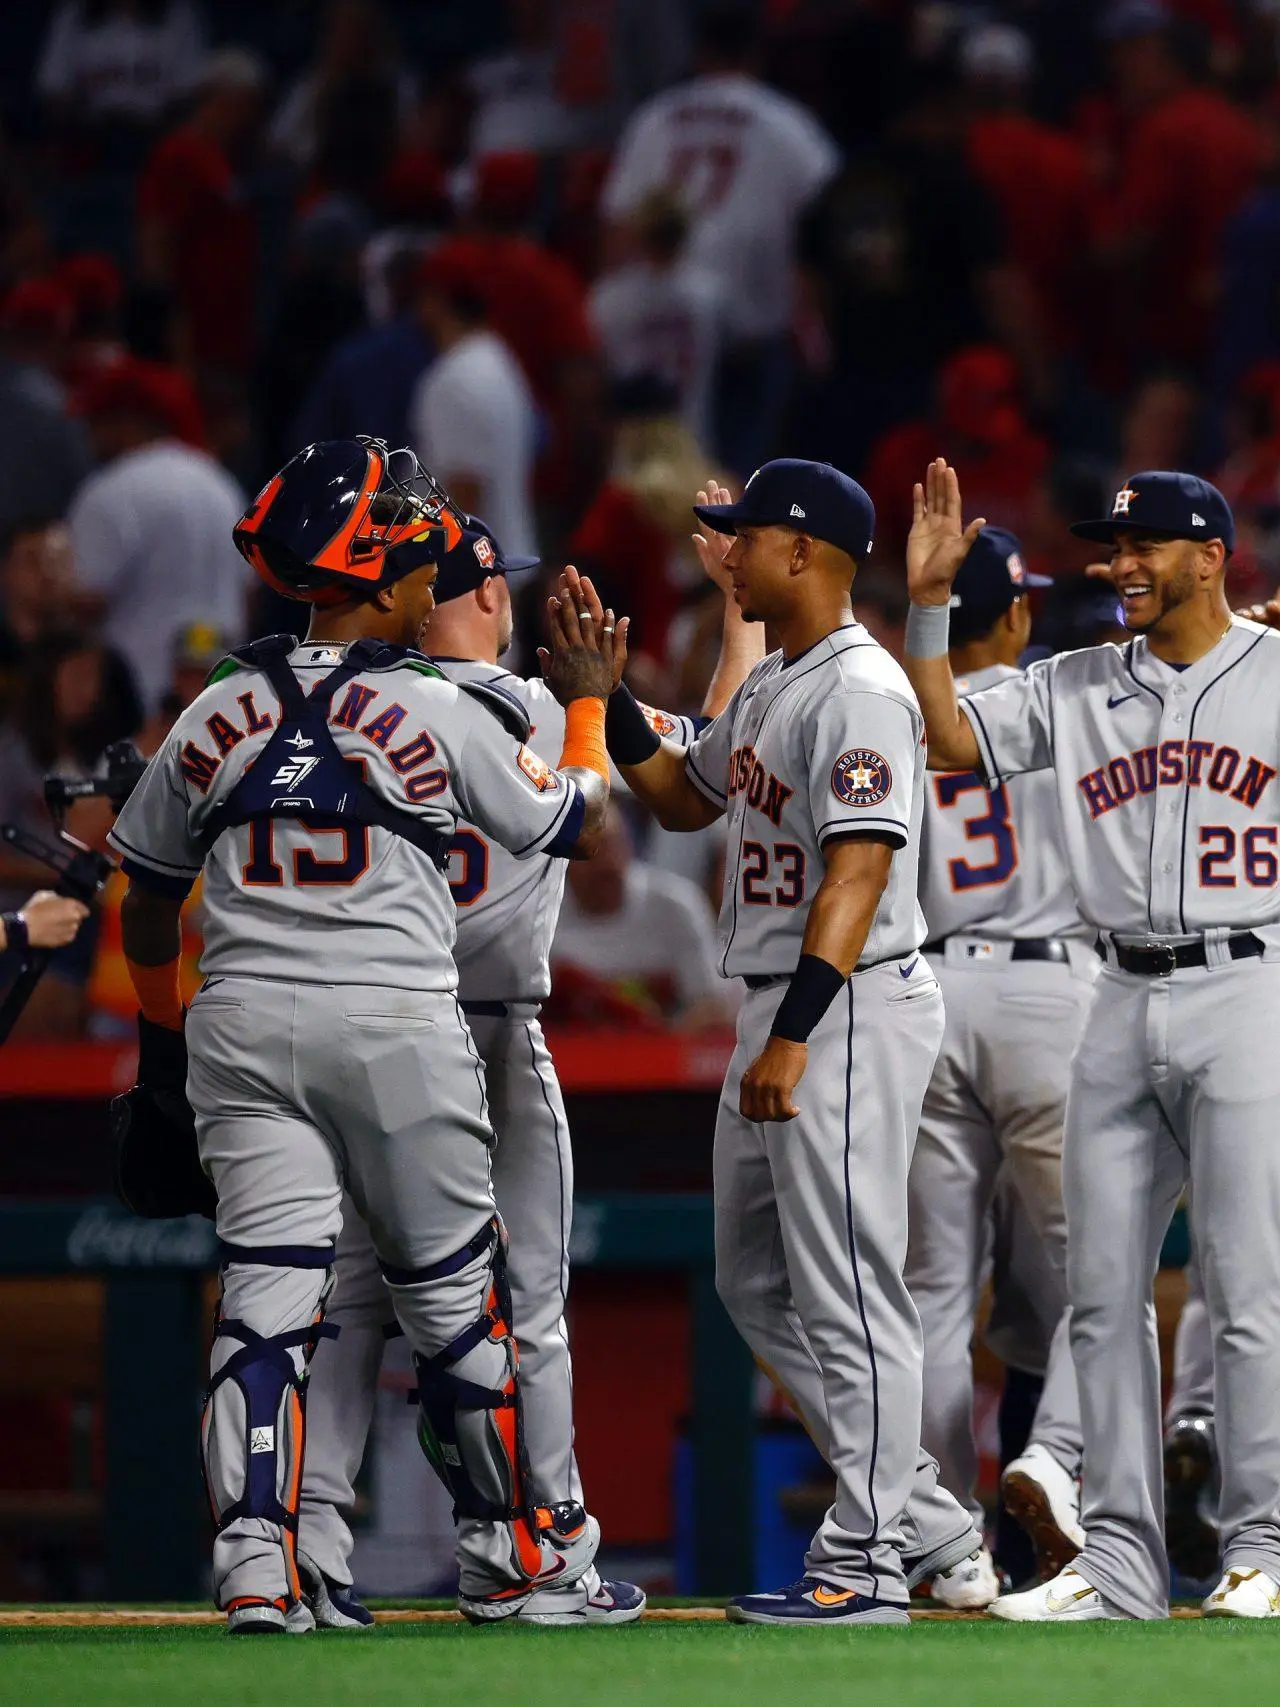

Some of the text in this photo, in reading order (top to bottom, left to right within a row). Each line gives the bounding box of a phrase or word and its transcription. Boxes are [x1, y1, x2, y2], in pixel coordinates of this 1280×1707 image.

[181, 679, 449, 805] MALNADO
[838, 752, 884, 770] HOUSTON
[843, 789, 884, 804] ASTROS
[850, 768, 873, 789] H
[1077, 740, 1279, 821] HOUSTON
[242, 757, 370, 886] 15
[742, 840, 806, 908] 23
[1199, 826, 1279, 888] 26
